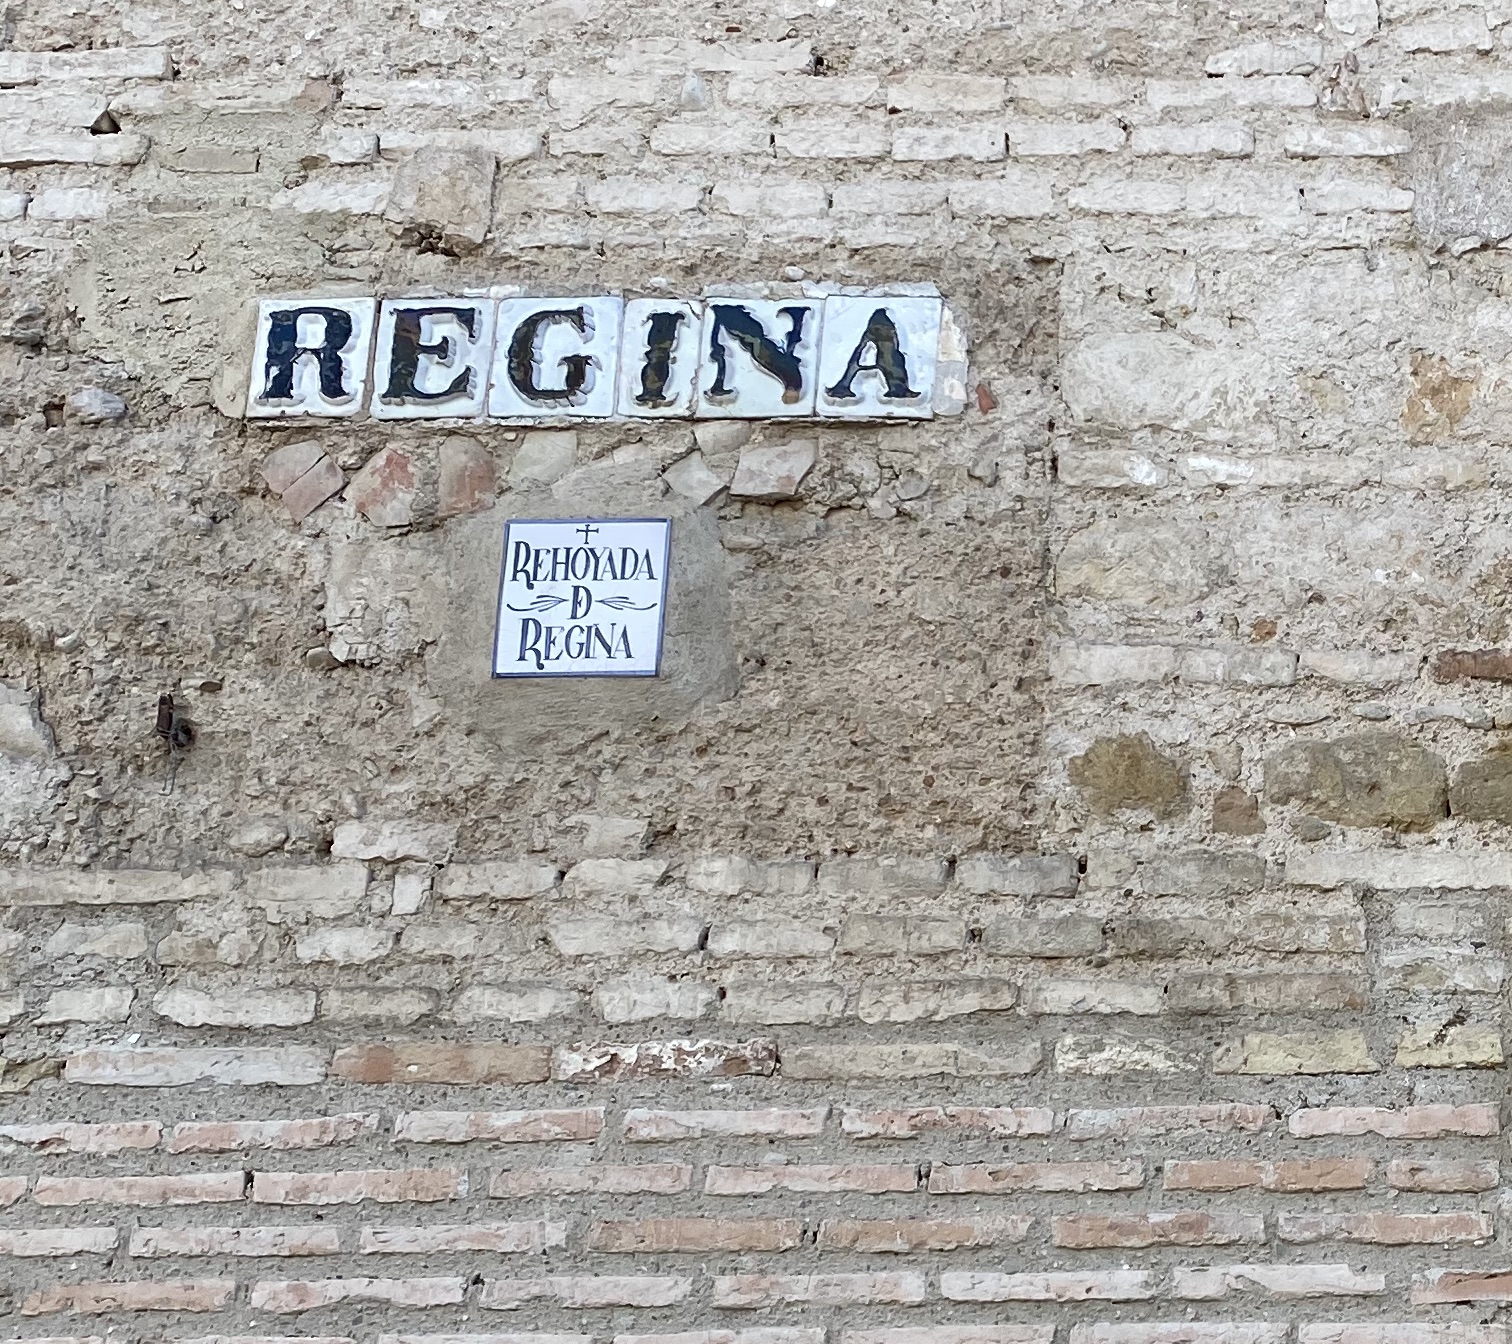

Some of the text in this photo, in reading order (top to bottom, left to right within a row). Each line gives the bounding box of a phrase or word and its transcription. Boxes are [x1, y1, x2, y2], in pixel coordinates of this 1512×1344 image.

[263, 305, 920, 405] REGINA
[509, 540, 658, 591] REHOYADA
[515, 617, 635, 670] REGINA
